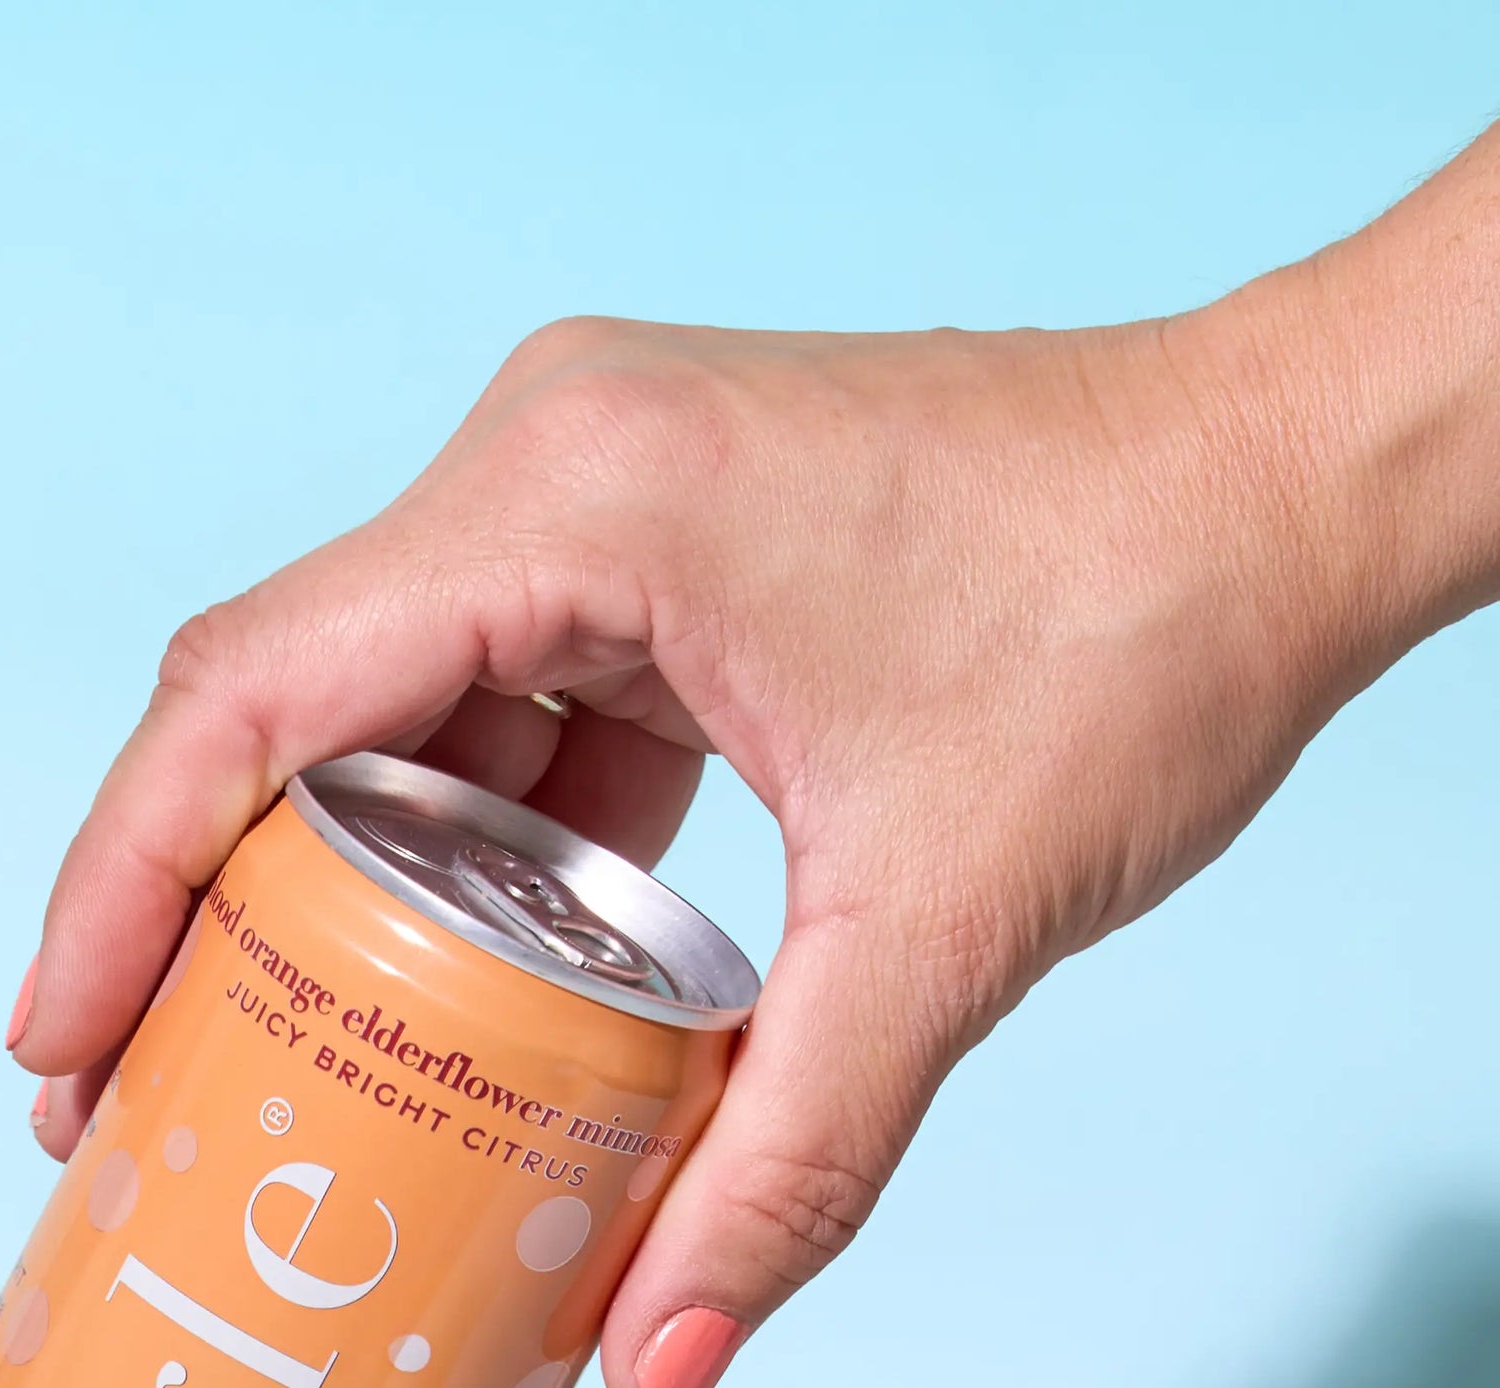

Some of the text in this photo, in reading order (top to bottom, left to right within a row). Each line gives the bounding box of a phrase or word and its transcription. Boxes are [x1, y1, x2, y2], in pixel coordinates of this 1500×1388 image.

[226, 980, 589, 1188] JUICY BRIGHT CITRUS
[240, 928, 336, 1014] orange
[341, 1004, 564, 1129] elderflower
[565, 1115, 684, 1160] mimosa
